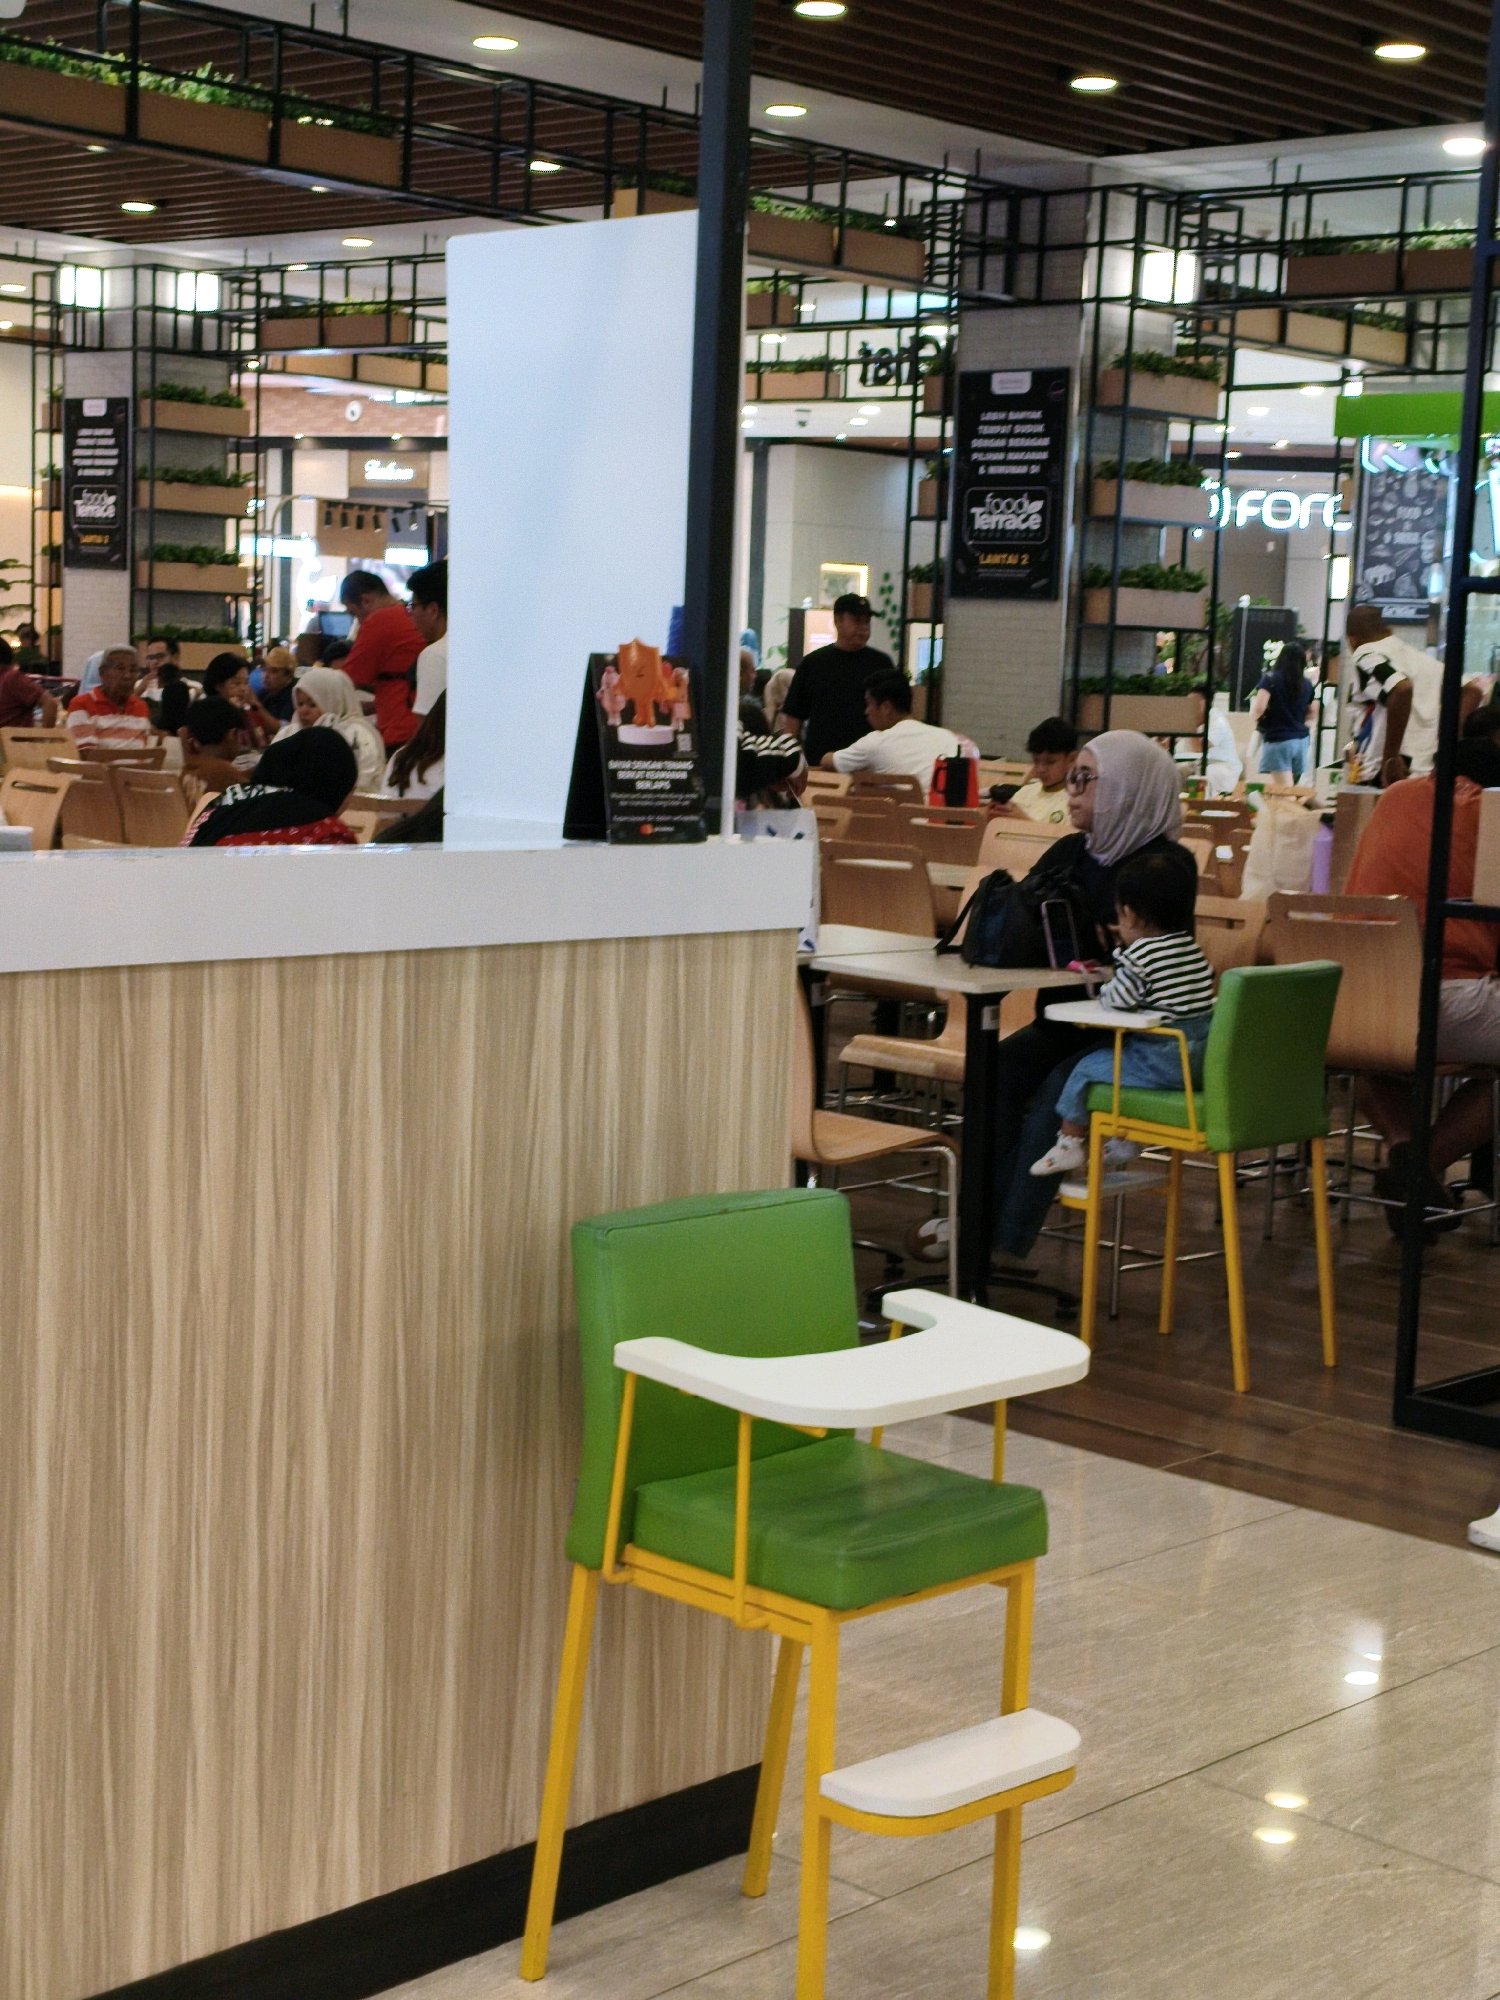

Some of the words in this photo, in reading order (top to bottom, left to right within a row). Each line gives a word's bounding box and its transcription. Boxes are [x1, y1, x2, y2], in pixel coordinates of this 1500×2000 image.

[985, 492, 1028, 514] food
[970, 507, 1043, 530] Terrace
[1020, 553, 1030, 565] 2
